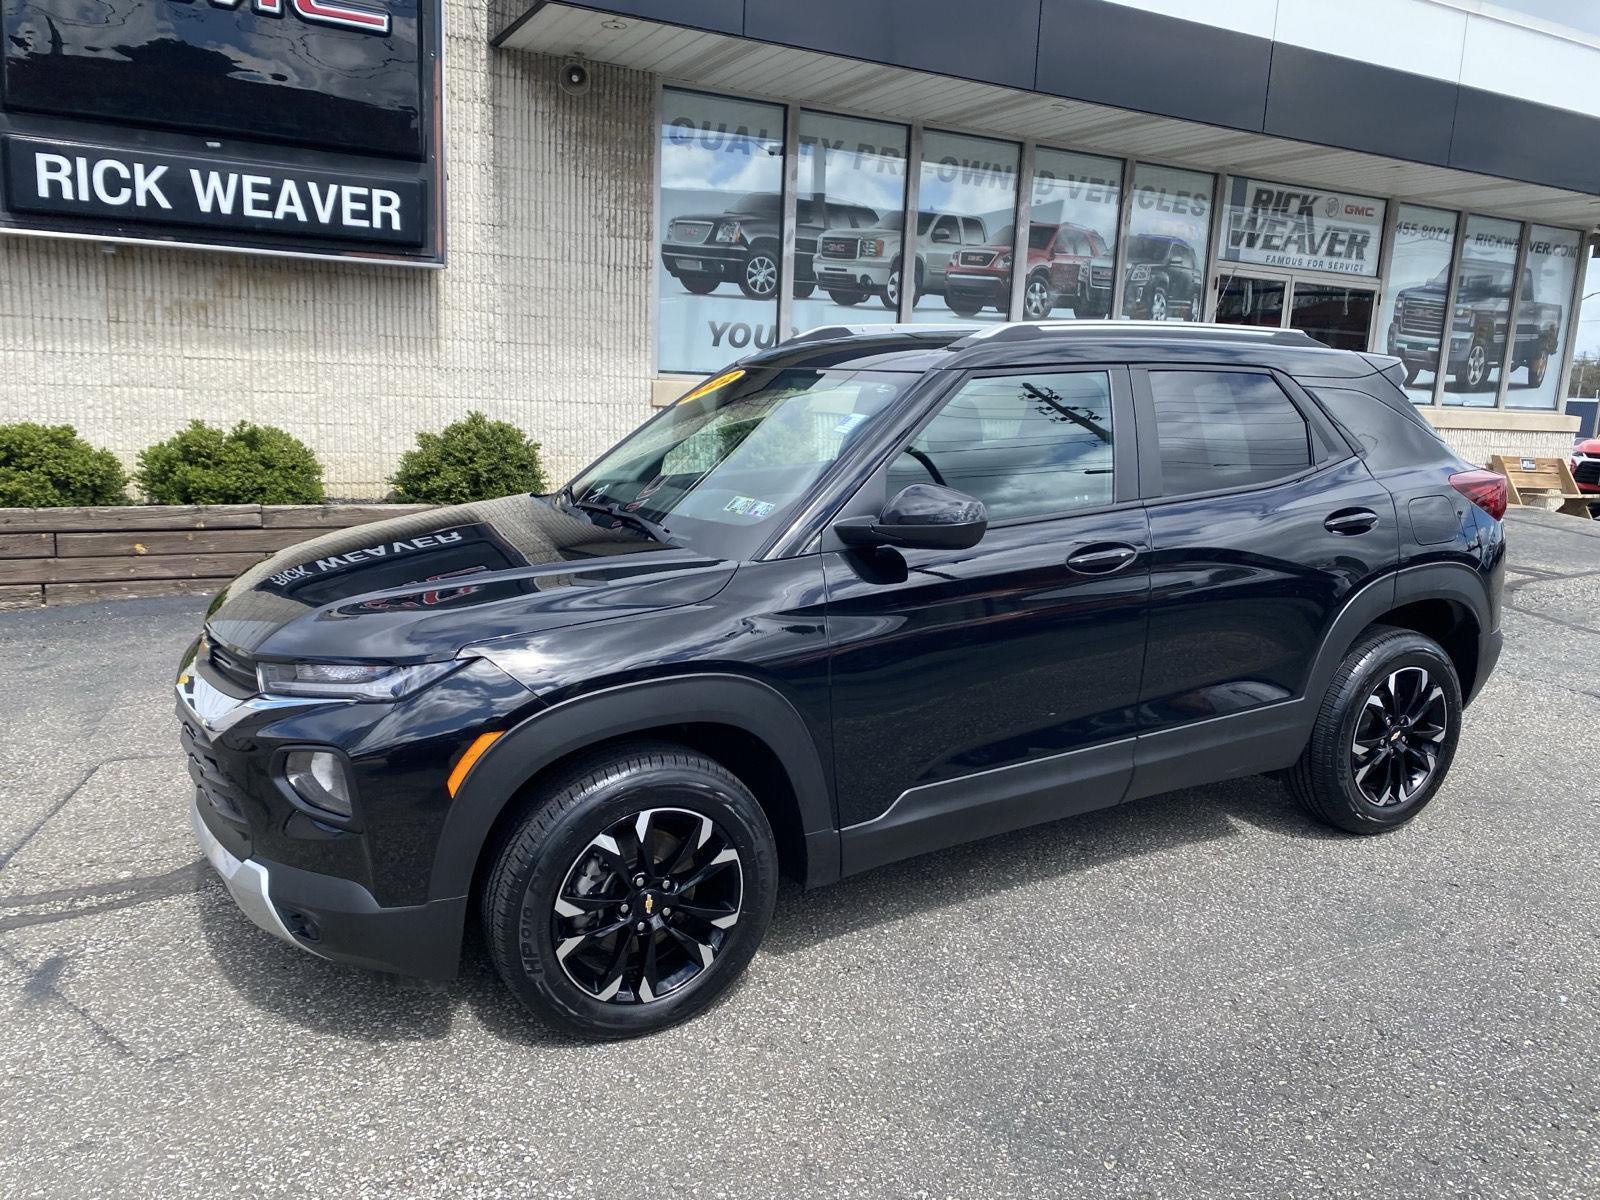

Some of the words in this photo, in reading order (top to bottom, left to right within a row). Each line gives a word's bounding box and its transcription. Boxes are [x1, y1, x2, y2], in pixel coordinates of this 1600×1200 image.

[35, 152, 173, 210] RICK
[189, 168, 401, 231] WEAVER
[1250, 186, 1322, 218] RICK
[1344, 204, 1376, 217] GMC
[1230, 214, 1371, 261] WEAVER
[1265, 254, 1302, 266] FAMOUS
[1307, 259, 1323, 269] FOR
[1327, 260, 1364, 272] SERVICE
